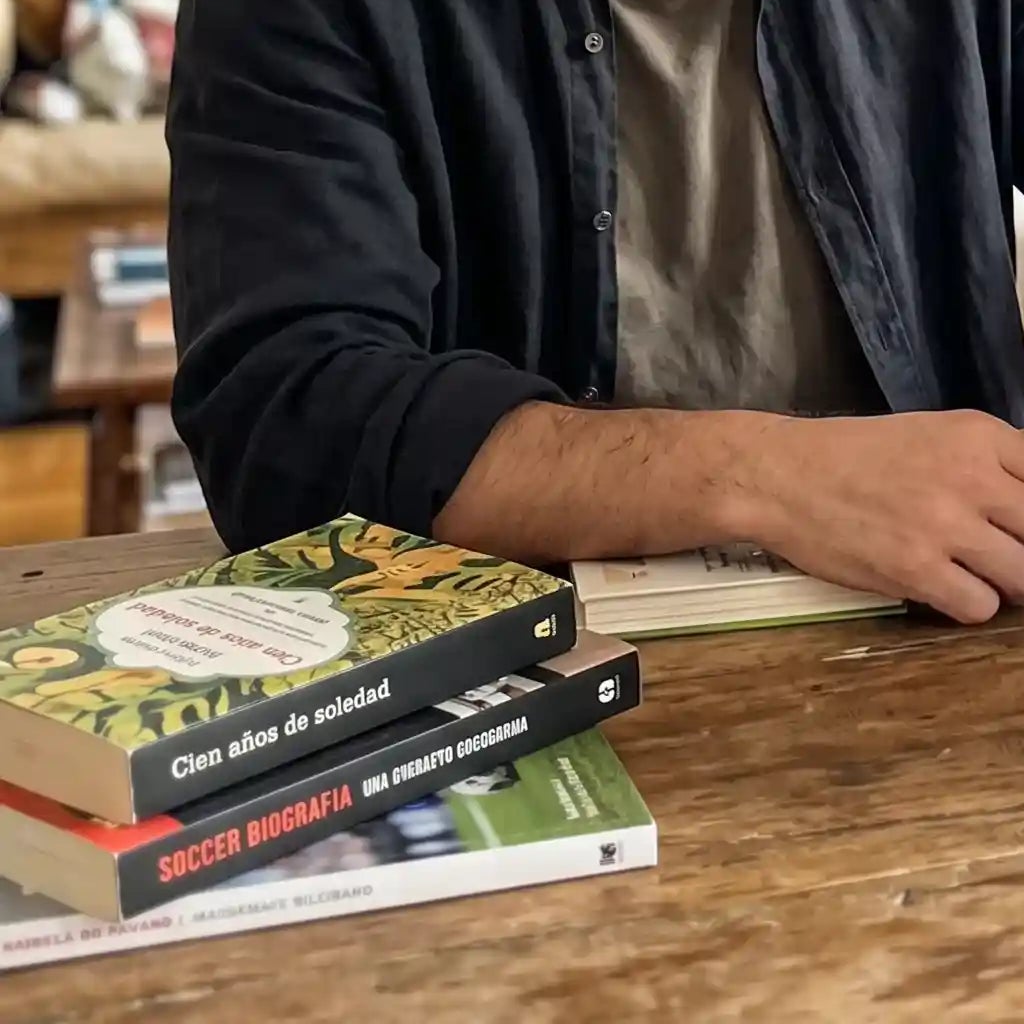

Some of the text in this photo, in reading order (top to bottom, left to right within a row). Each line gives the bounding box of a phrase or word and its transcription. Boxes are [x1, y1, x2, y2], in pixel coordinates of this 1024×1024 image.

[171, 678, 391, 779] Cien años de soledad
[158, 784, 353, 883] SOCCER BIOGRAFIA
[362, 773, 389, 798] UNA
